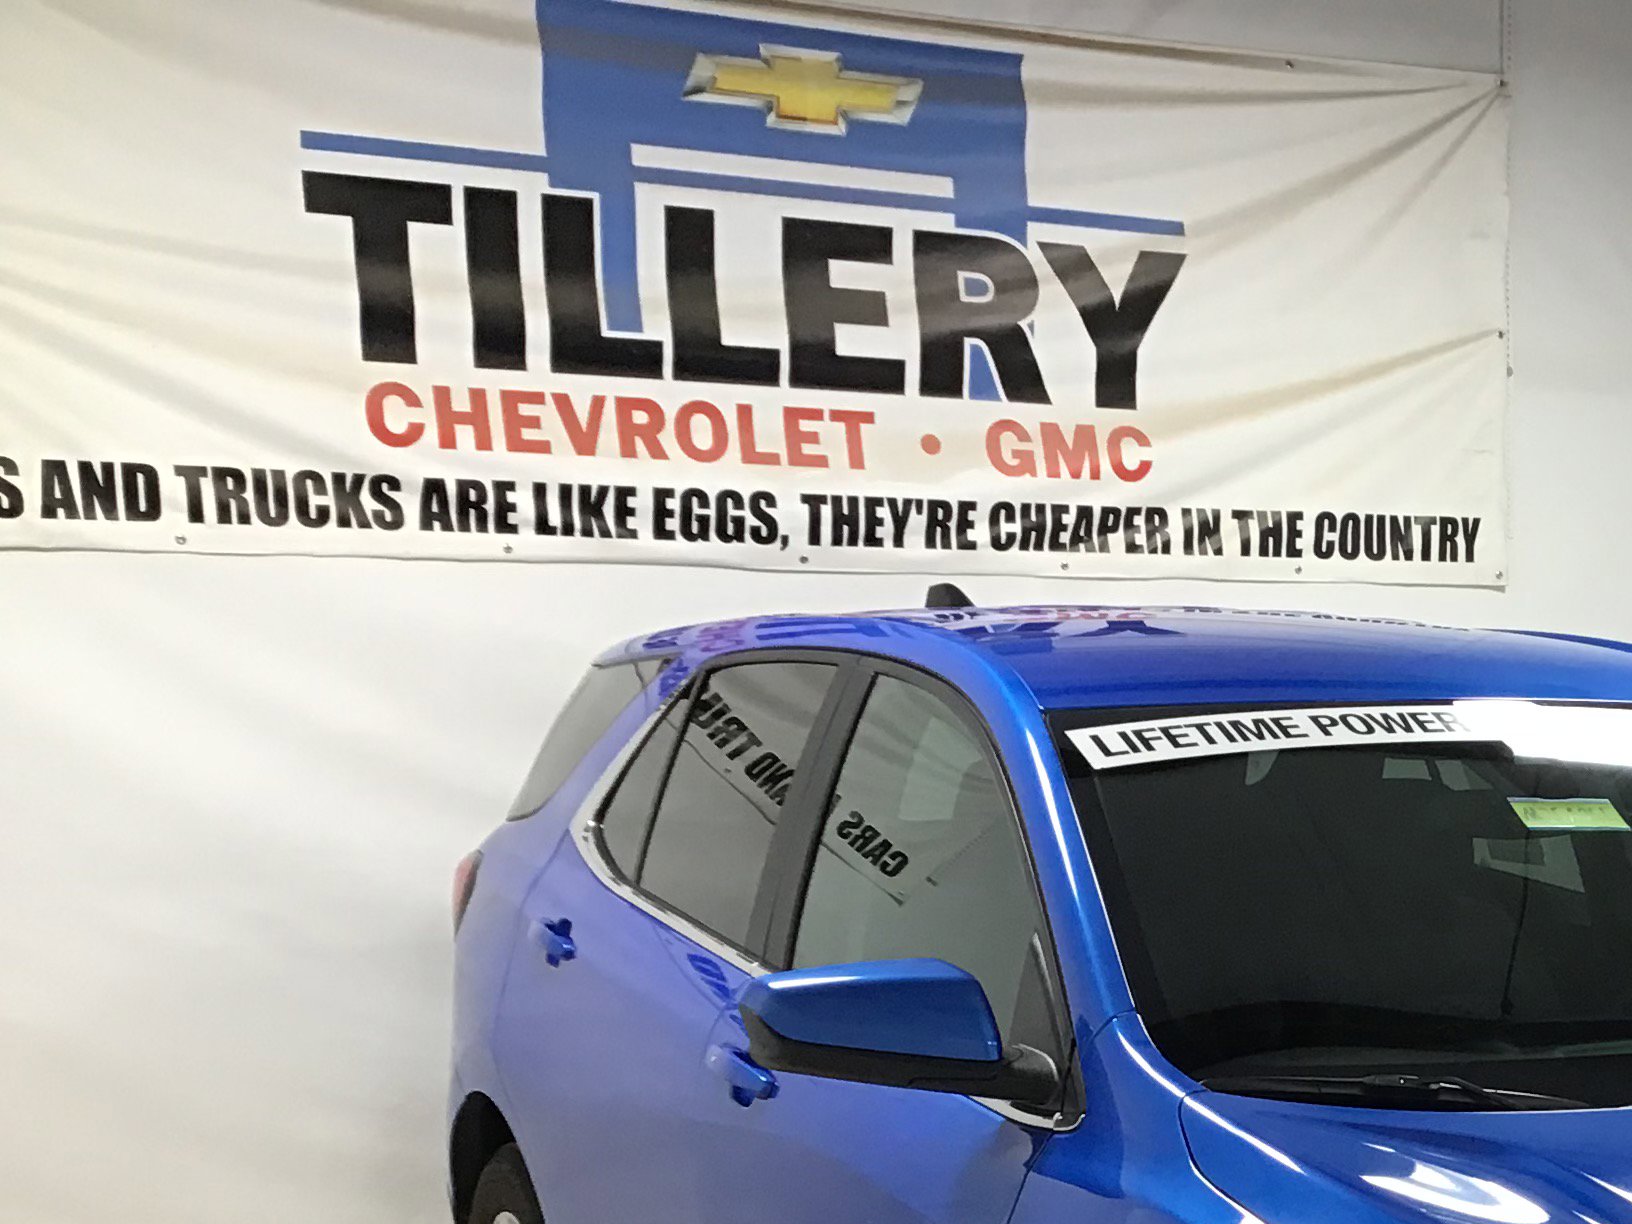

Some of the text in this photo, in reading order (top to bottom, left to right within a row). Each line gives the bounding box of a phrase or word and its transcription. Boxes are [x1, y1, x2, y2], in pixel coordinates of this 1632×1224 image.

[301, 170, 1187, 410] TILLERY
[364, 381, 1153, 482] CHEVROLET GMC
[41, 459, 161, 521] AND
[174, 465, 404, 531] TRUCKS
[419, 477, 519, 534] ARE
[532, 481, 639, 540] LIKE
[652, 486, 790, 551] EGGS,
[800, 494, 977, 550] THEY'RE
[988, 501, 1170, 556] CHEAPER
[1181, 507, 1225, 557] IN
[1231, 509, 1305, 560] THE
[1313, 512, 1481, 564] COUNTRY
[1089, 716, 1311, 757] LIFETIME
